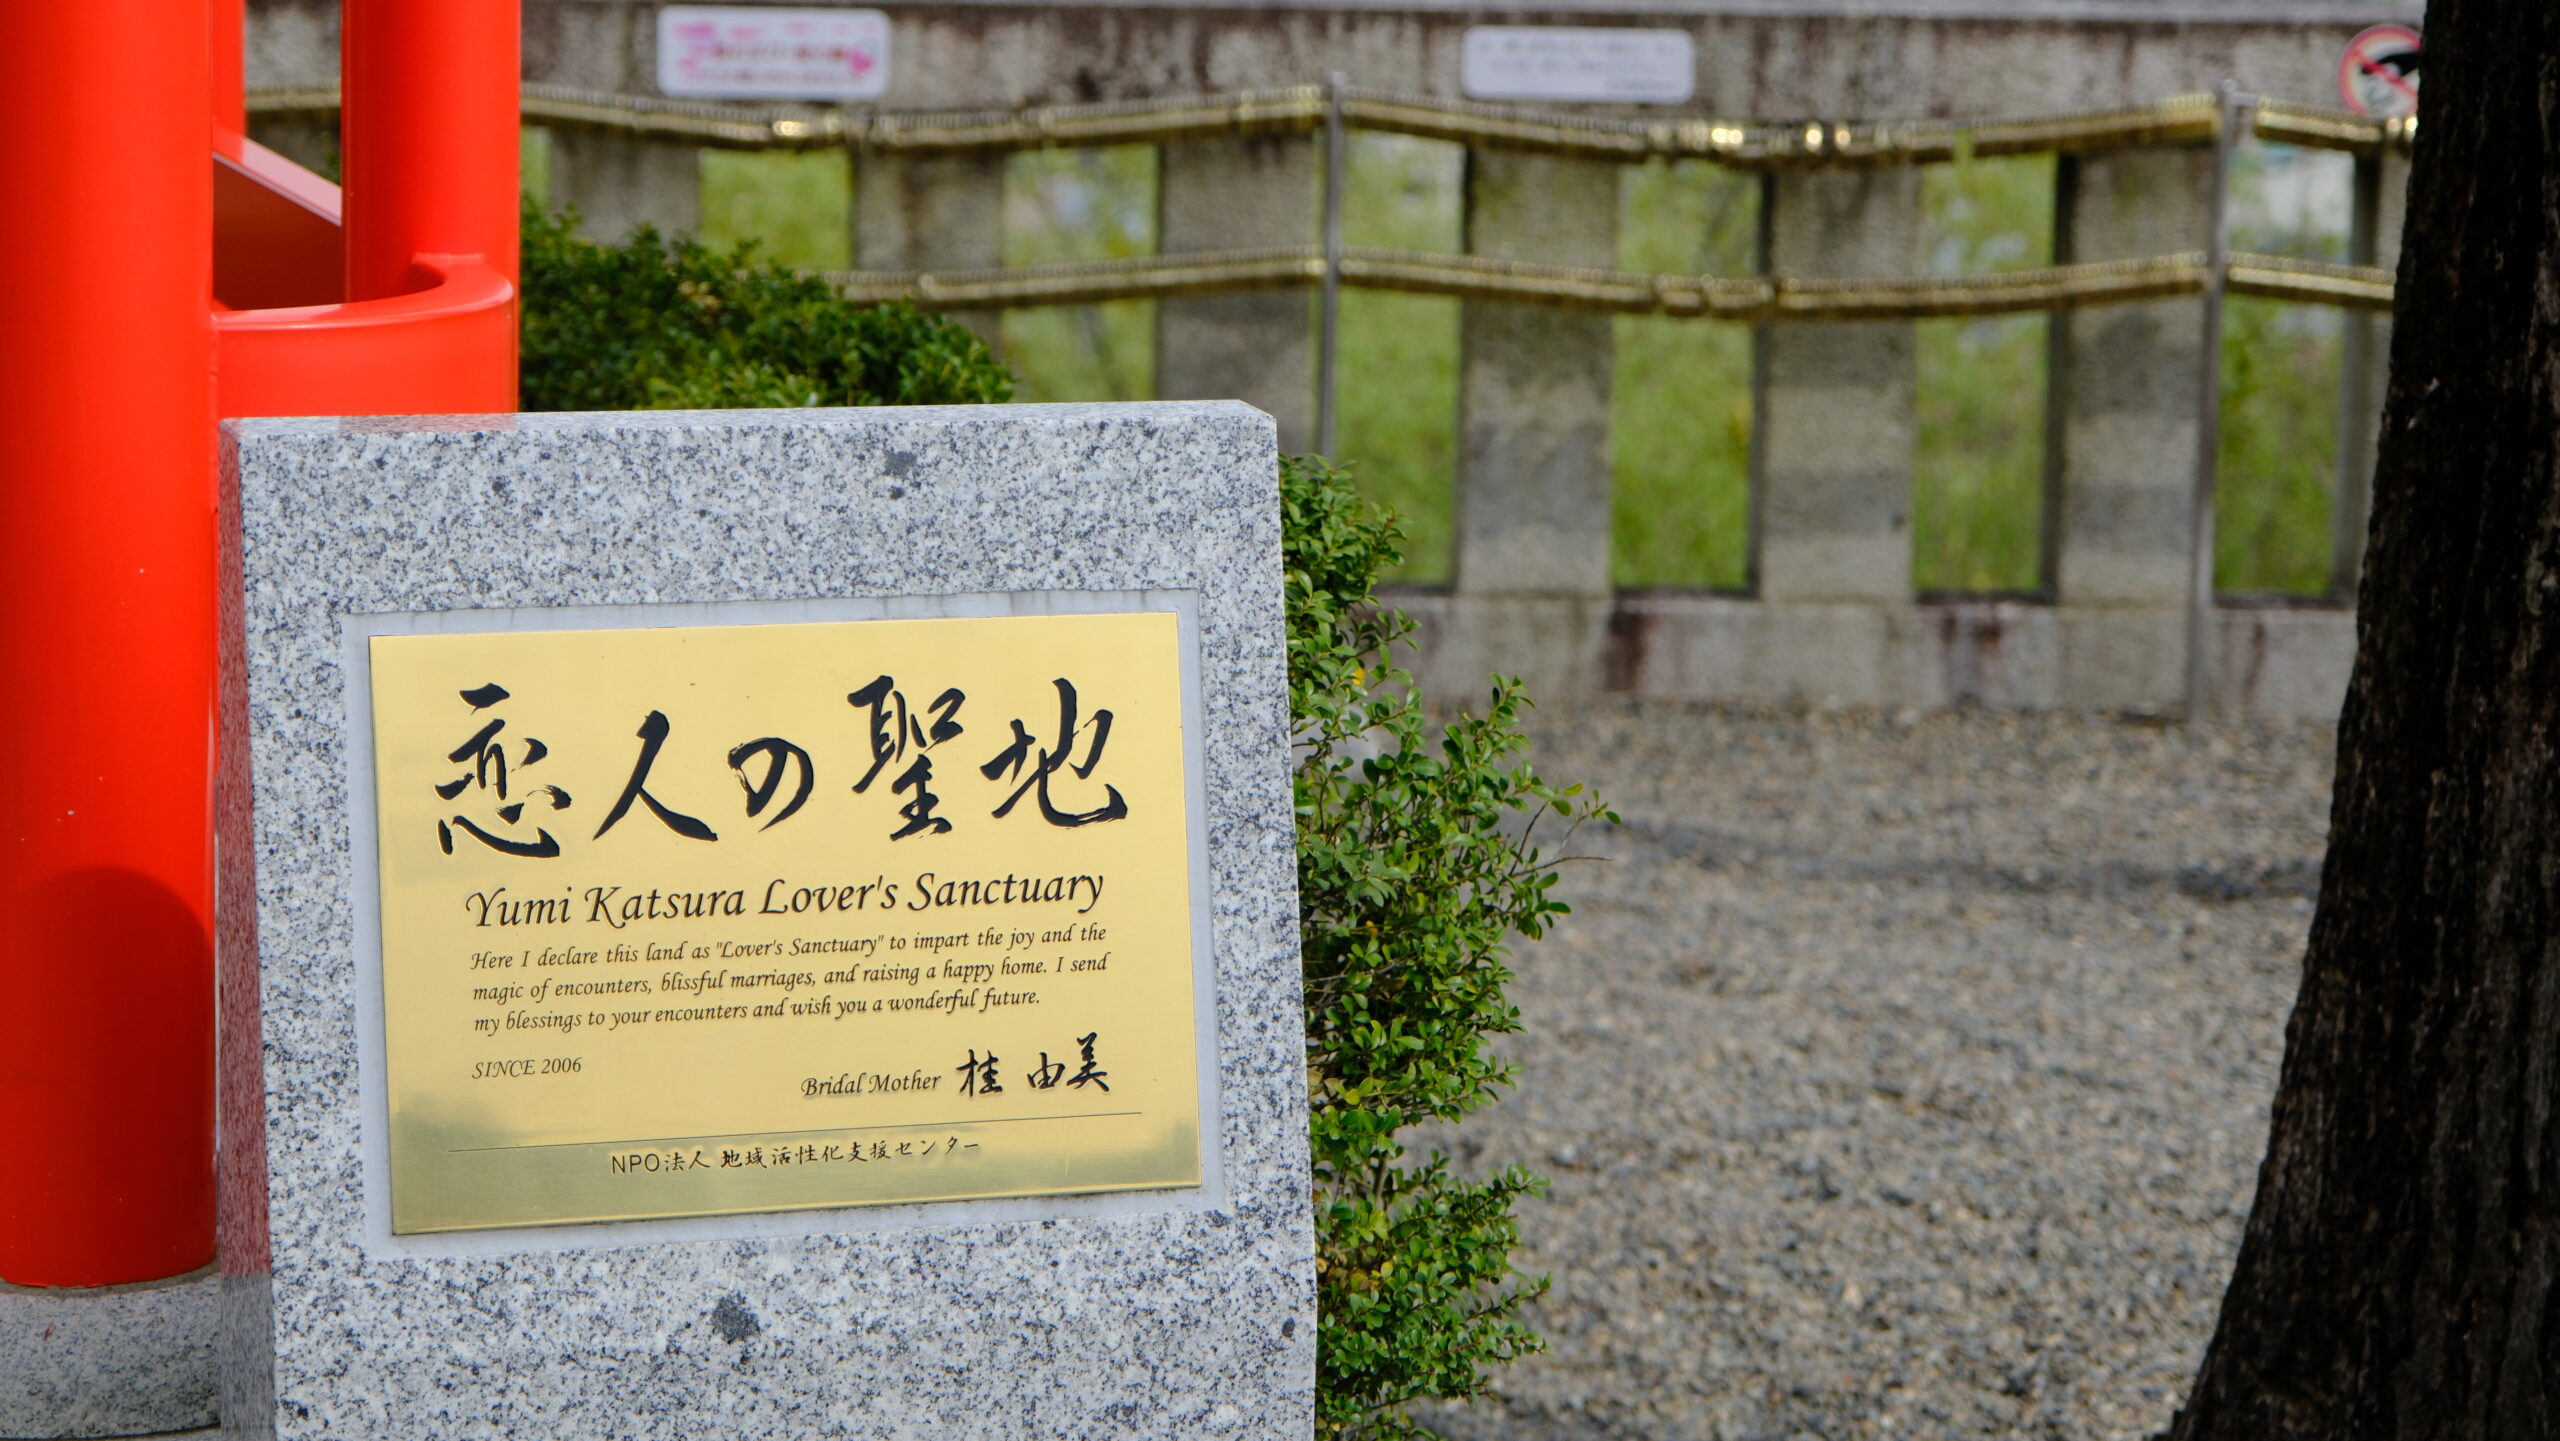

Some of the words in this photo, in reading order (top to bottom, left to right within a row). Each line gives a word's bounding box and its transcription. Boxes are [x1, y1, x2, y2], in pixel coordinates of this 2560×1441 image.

[434, 674, 1129, 859] 恋人の聖地
[465, 885, 573, 928] Yumi
[583, 886, 747, 930] Katsura
[757, 874, 899, 915] Lover's
[906, 872, 1104, 915] Sanctuary
[470, 950, 513, 970] Here
[520, 950, 531, 968] I
[537, 945, 599, 967] declare
[606, 943, 639, 964] this
[645, 940, 689, 962] land
[691, 946, 711, 960] as
[716, 939, 784, 959] "Lover's
[788, 934, 885, 959] Sanctuary"
[889, 935, 907, 951] to
[913, 931, 970, 955] impart
[976, 926, 1004, 947] the
[1009, 927, 1035, 952] joy
[1041, 922, 1078, 944] and
[1080, 921, 1107, 942] the
[472, 981, 524, 1006] magic
[530, 977, 553, 1004] of
[554, 978, 652, 997] encounters,
[660, 969, 728, 997] blissful
[730, 968, 816, 993] marriages,
[823, 962, 861, 985] and
[862, 962, 920, 987] raising
[925, 966, 937, 980] a
[942, 958, 995, 985] happy
[1000, 955, 1047, 976] home.
[1055, 956, 1065, 973] I
[1069, 951, 1112, 972] send
[474, 1018, 500, 1038] my
[505, 1009, 583, 1034] blessings
[588, 1011, 606, 1026] to
[608, 1010, 652, 1031] your
[654, 1004, 749, 1023] encounters
[752, 996, 790, 1018] and
[789, 994, 832, 1016] wish
[834, 1000, 868, 1022] you
[872, 999, 883, 1013] a
[887, 987, 980, 1015] wonderful
[978, 986, 1040, 1014] future.
[471, 1059, 536, 1080] SINCE
[540, 1056, 582, 1075] 2006
[800, 1071, 868, 1097] Bridal
[867, 1068, 942, 1094] Mother
